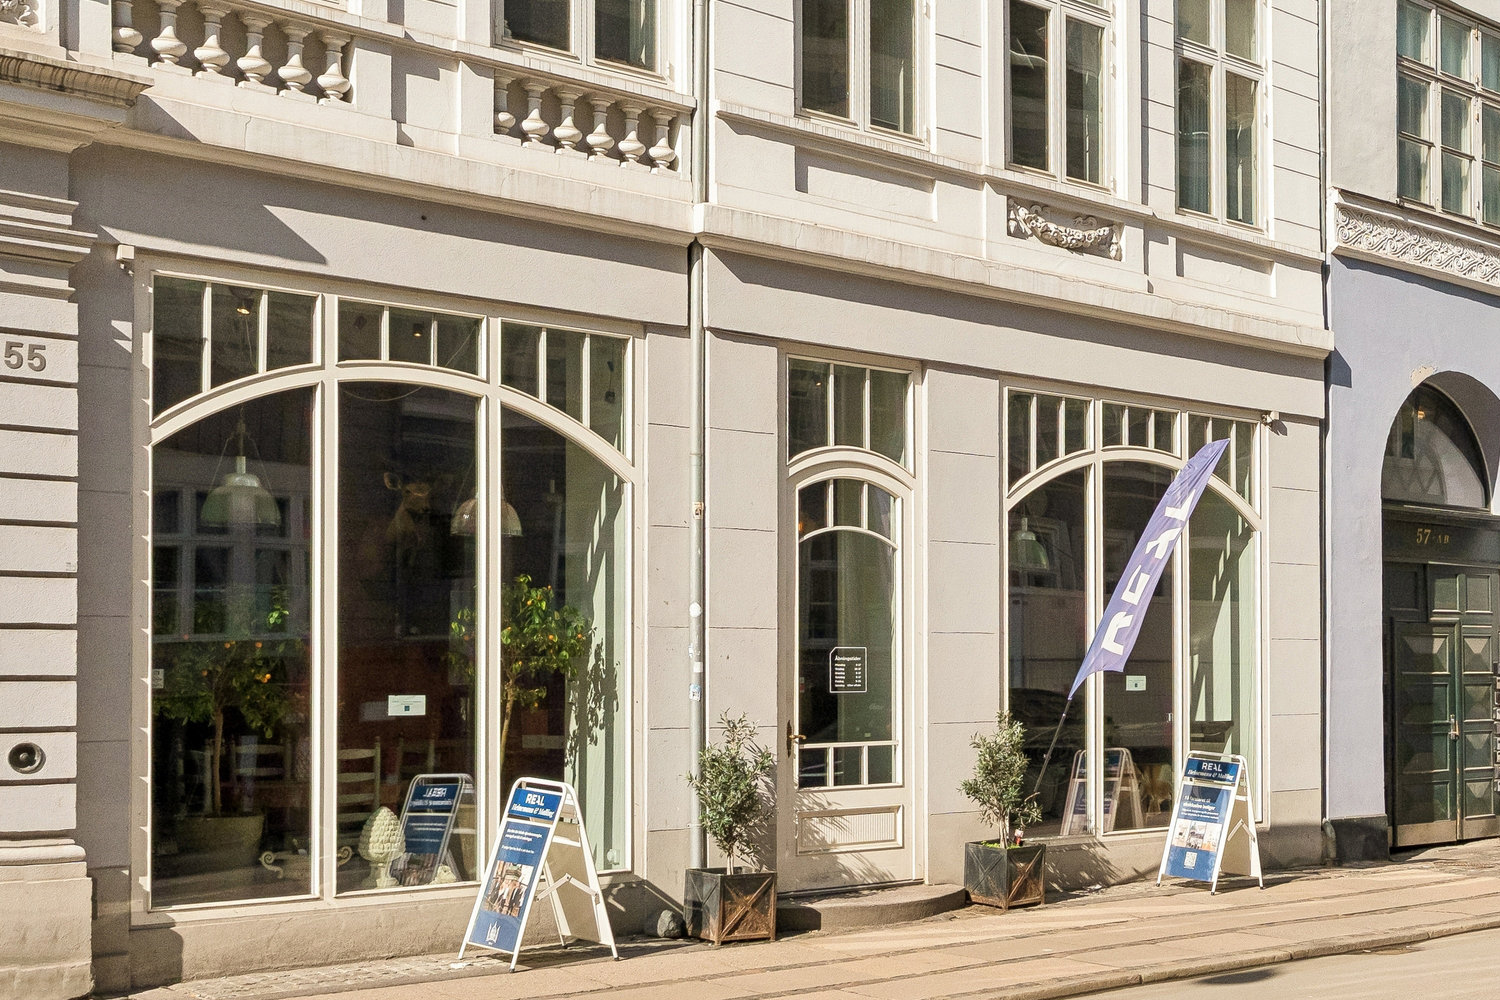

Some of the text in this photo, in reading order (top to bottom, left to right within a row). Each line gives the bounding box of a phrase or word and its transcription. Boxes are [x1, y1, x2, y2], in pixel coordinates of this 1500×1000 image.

[4, 341, 47, 372] 55
[1416, 528, 1432, 545] 57
[1202, 762, 1222, 772] REAL
[525, 793, 545, 806] REAL
